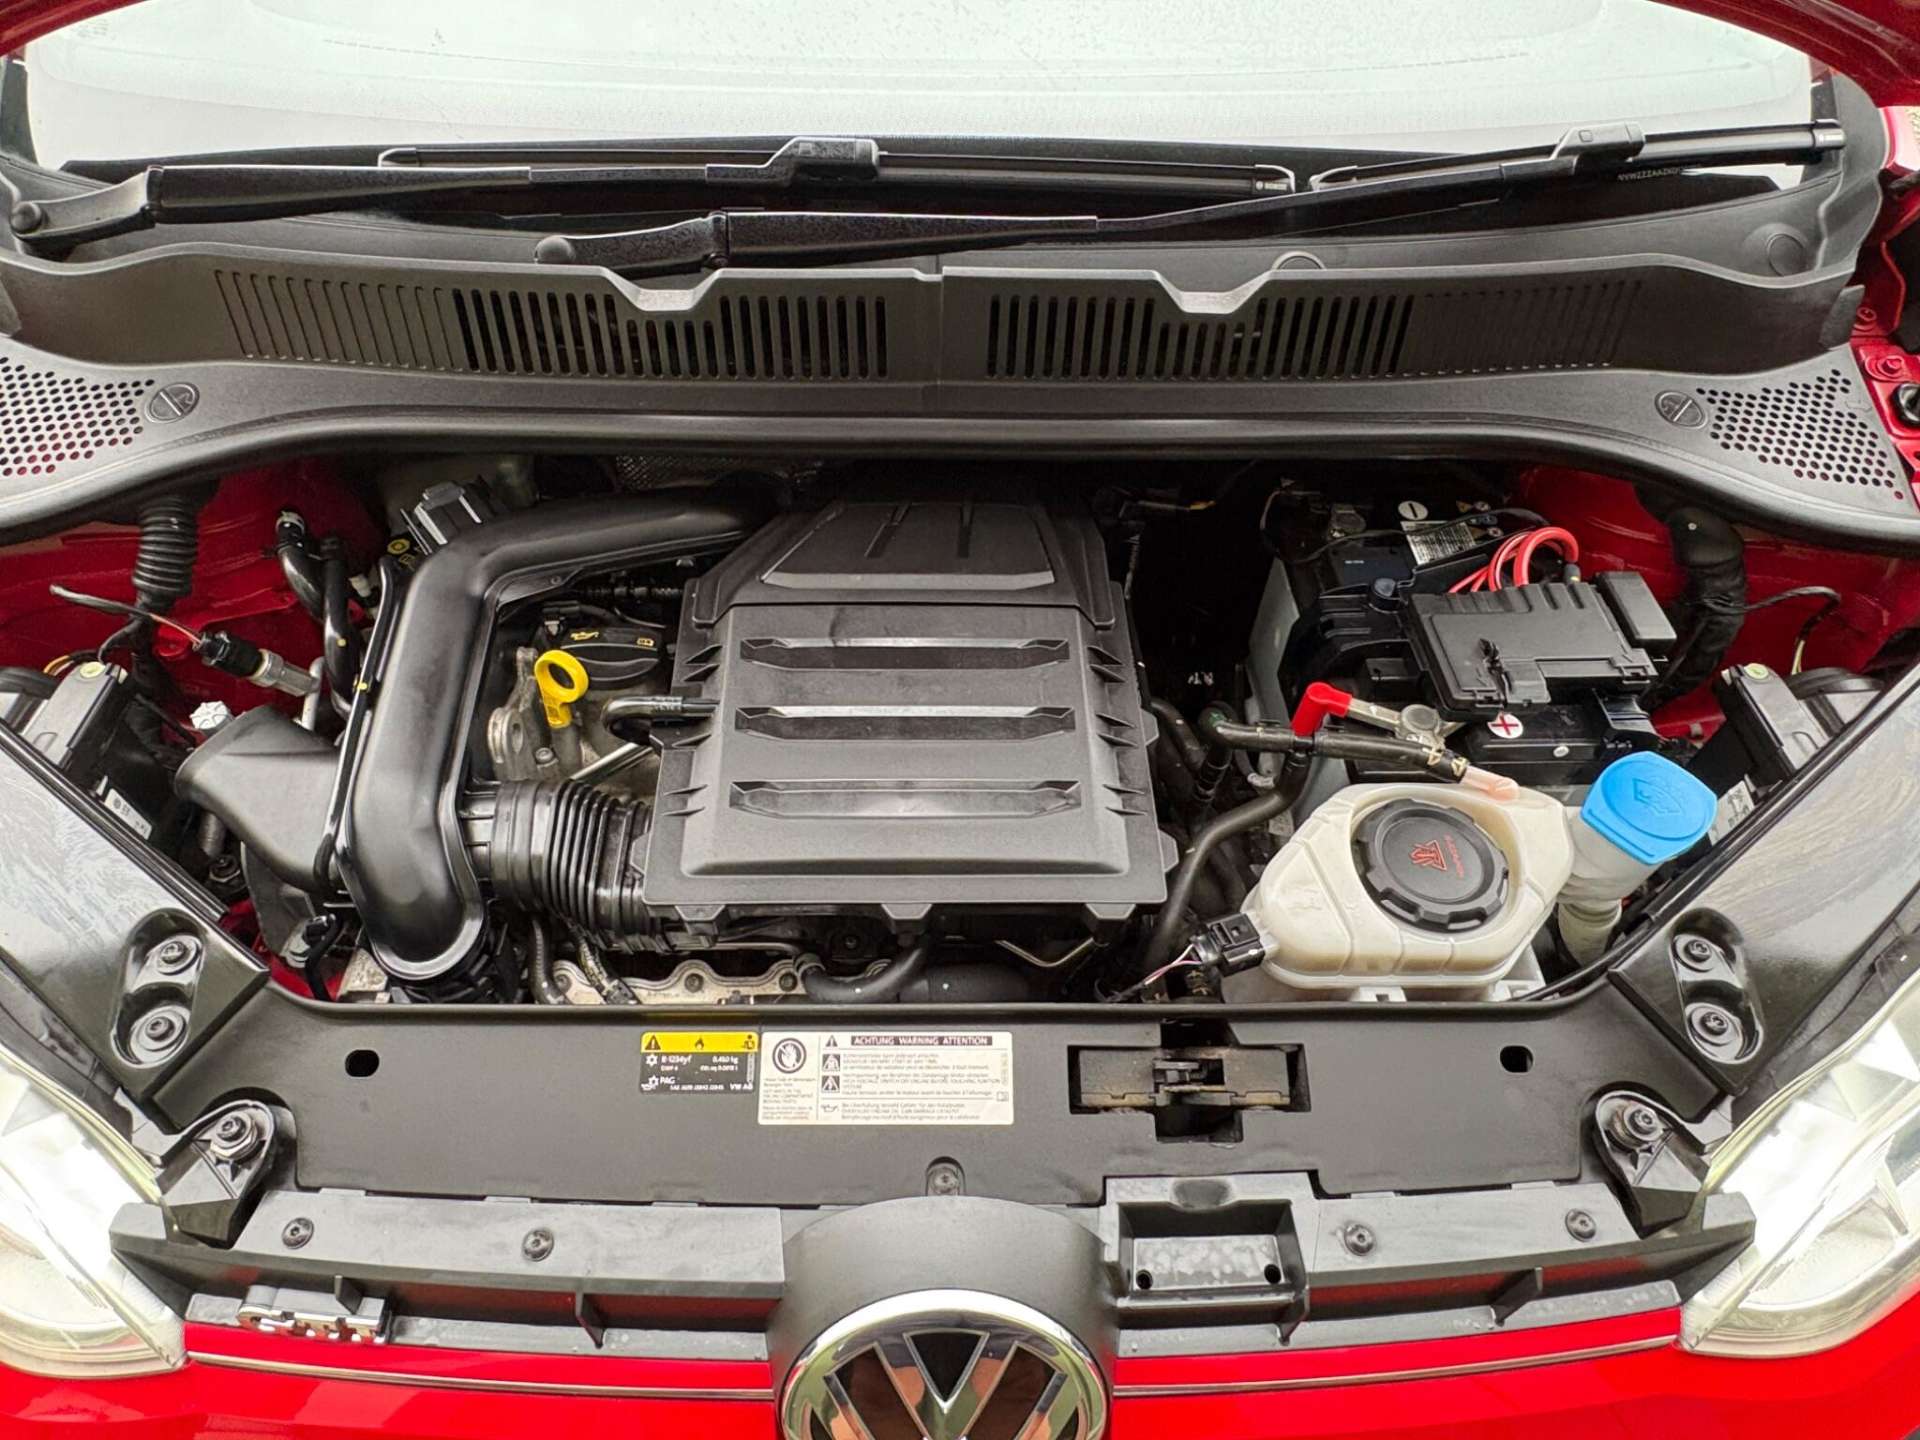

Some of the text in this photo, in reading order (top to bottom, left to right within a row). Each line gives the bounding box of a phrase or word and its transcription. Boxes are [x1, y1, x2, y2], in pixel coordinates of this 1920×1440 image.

[853, 1036, 989, 1045] ACHTUNG WARNING ATTENTION
[659, 1076, 676, 1084] PAG
[730, 1083, 742, 1091] VW
[743, 1083, 754, 1091] AG
